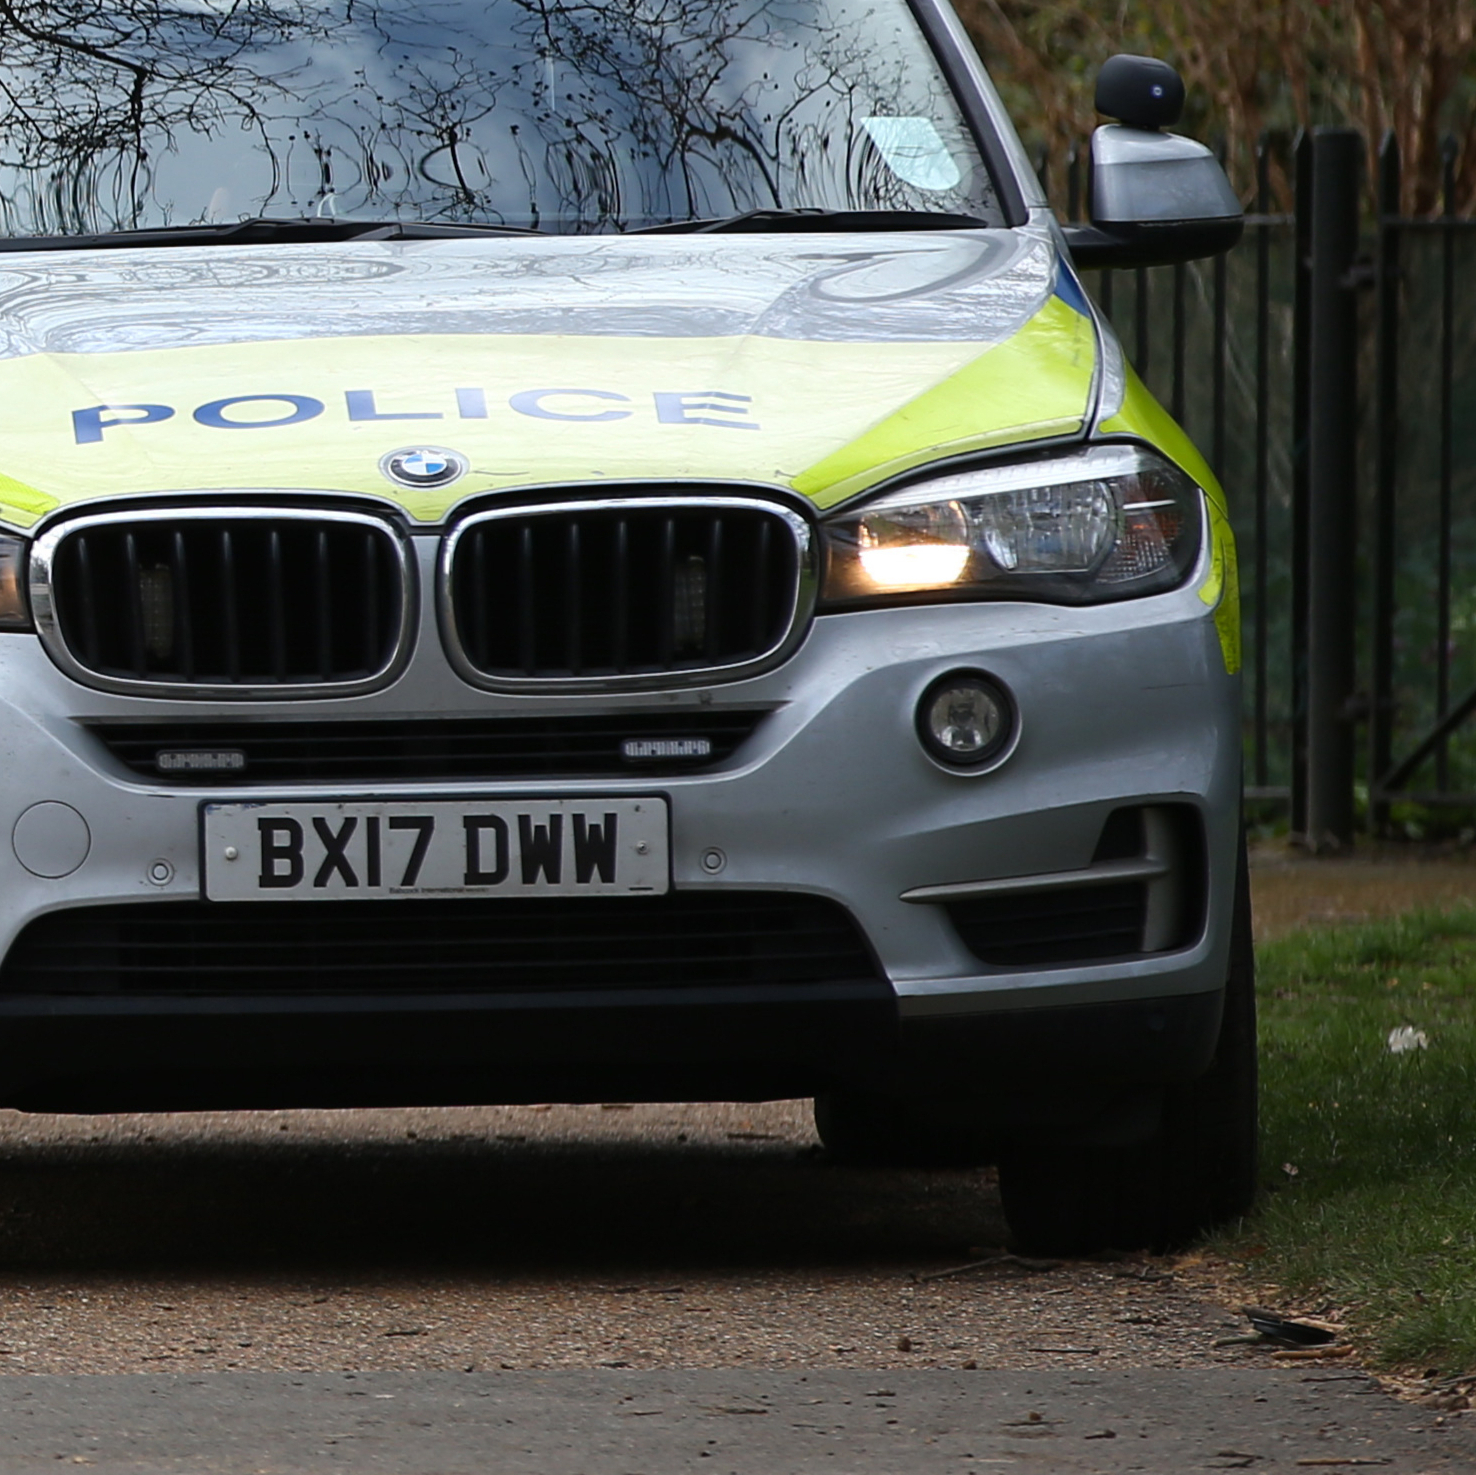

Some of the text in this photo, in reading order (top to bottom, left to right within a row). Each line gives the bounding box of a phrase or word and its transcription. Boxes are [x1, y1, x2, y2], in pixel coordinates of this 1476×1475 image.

[72, 387, 762, 445] POLICE
[257, 812, 619, 889] BX17 DWW
